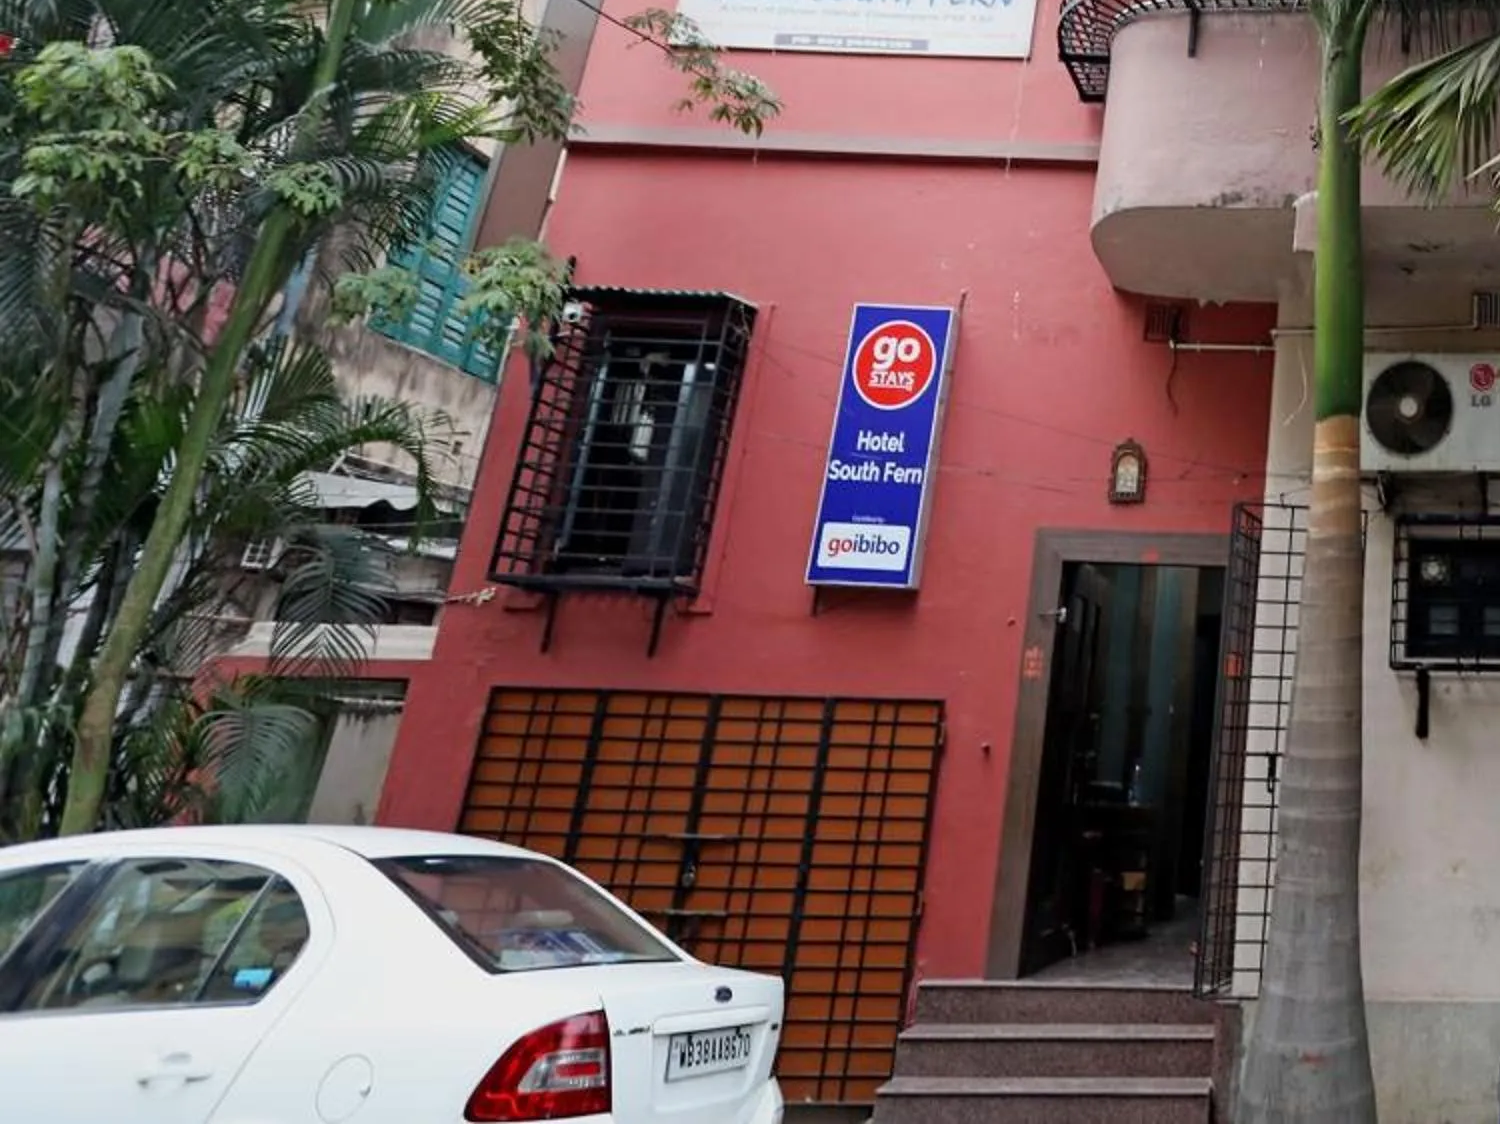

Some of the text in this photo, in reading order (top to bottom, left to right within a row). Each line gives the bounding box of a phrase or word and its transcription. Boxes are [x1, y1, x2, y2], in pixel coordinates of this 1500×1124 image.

[872, 335, 920, 369] go
[869, 370, 915, 387] STAYS
[1471, 394, 1491, 407] LG
[856, 431, 905, 453] Hotel
[828, 460, 922, 484] South Fern
[827, 534, 900, 557] goibibo
